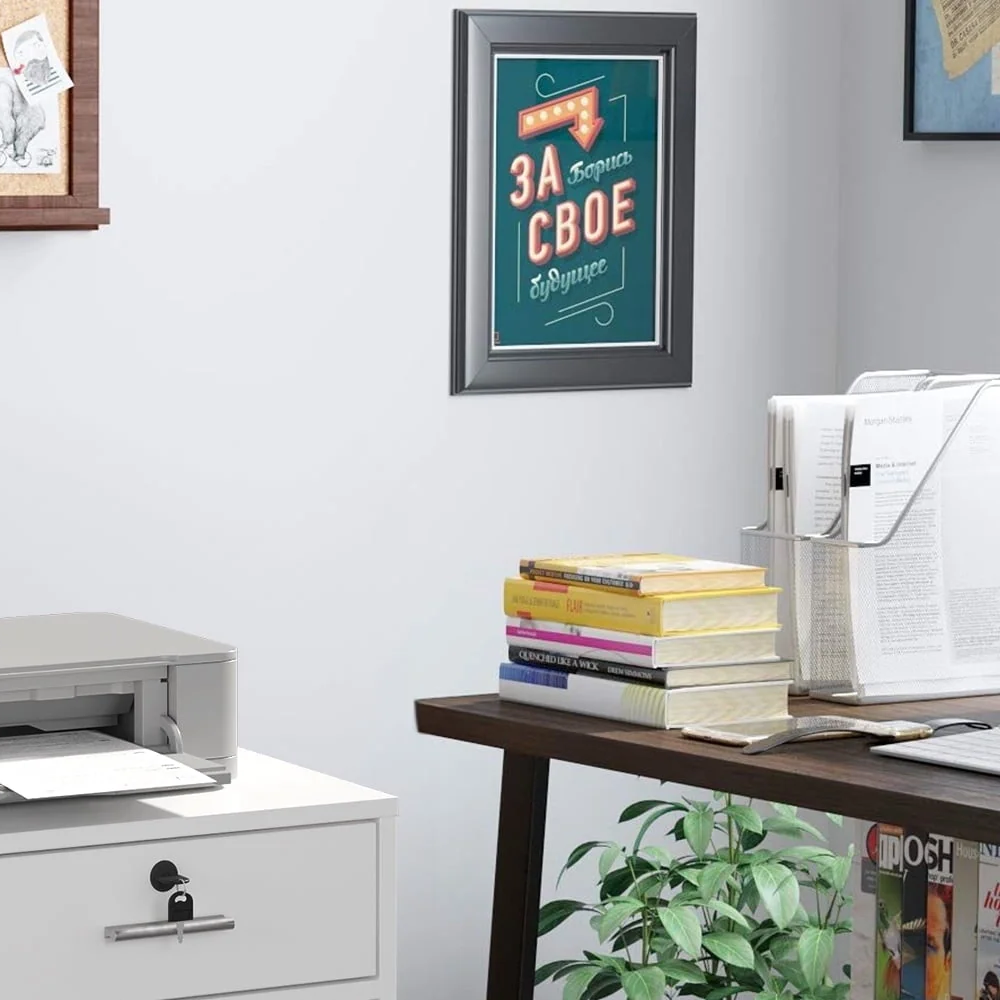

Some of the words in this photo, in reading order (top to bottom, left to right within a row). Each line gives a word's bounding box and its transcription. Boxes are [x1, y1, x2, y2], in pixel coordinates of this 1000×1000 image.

[509, 143, 564, 211] ЗА
[566, 150, 634, 185] Борись
[527, 177, 637, 267] СВОЕ
[529, 256, 609, 303] будущее
